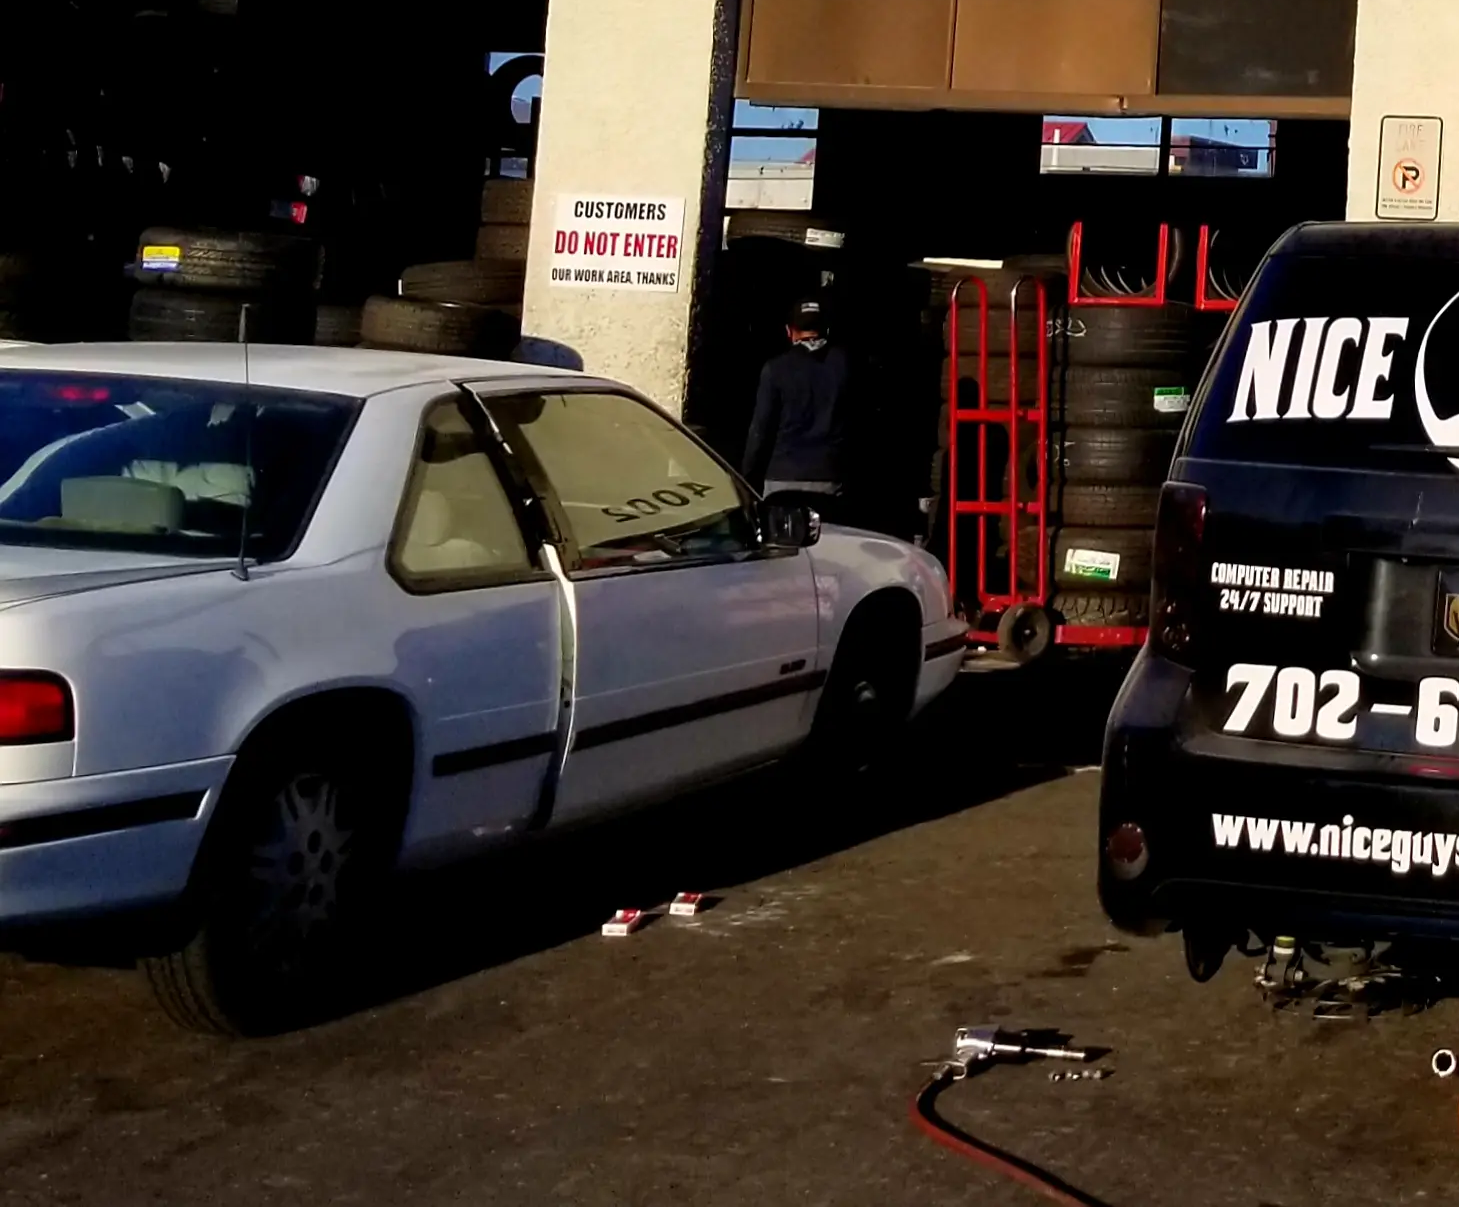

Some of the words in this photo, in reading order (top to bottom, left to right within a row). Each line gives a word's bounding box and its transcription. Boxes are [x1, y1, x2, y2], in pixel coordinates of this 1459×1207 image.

[574, 200, 667, 221] CUSTOMERS
[554, 230, 579, 255] DO
[583, 231, 620, 256] NOT
[623, 233, 679, 259] ENTER
[551, 268, 572, 281] OUR
[574, 268, 605, 283] WORK
[636, 271, 676, 286] THANKS
[1226, 317, 1409, 423] NICE
[1210, 562, 1280, 589] COMPUTER
[1283, 568, 1335, 593] REPAIR
[1220, 589, 1261, 612] 24/7
[1263, 592, 1323, 618] SUPPORT
